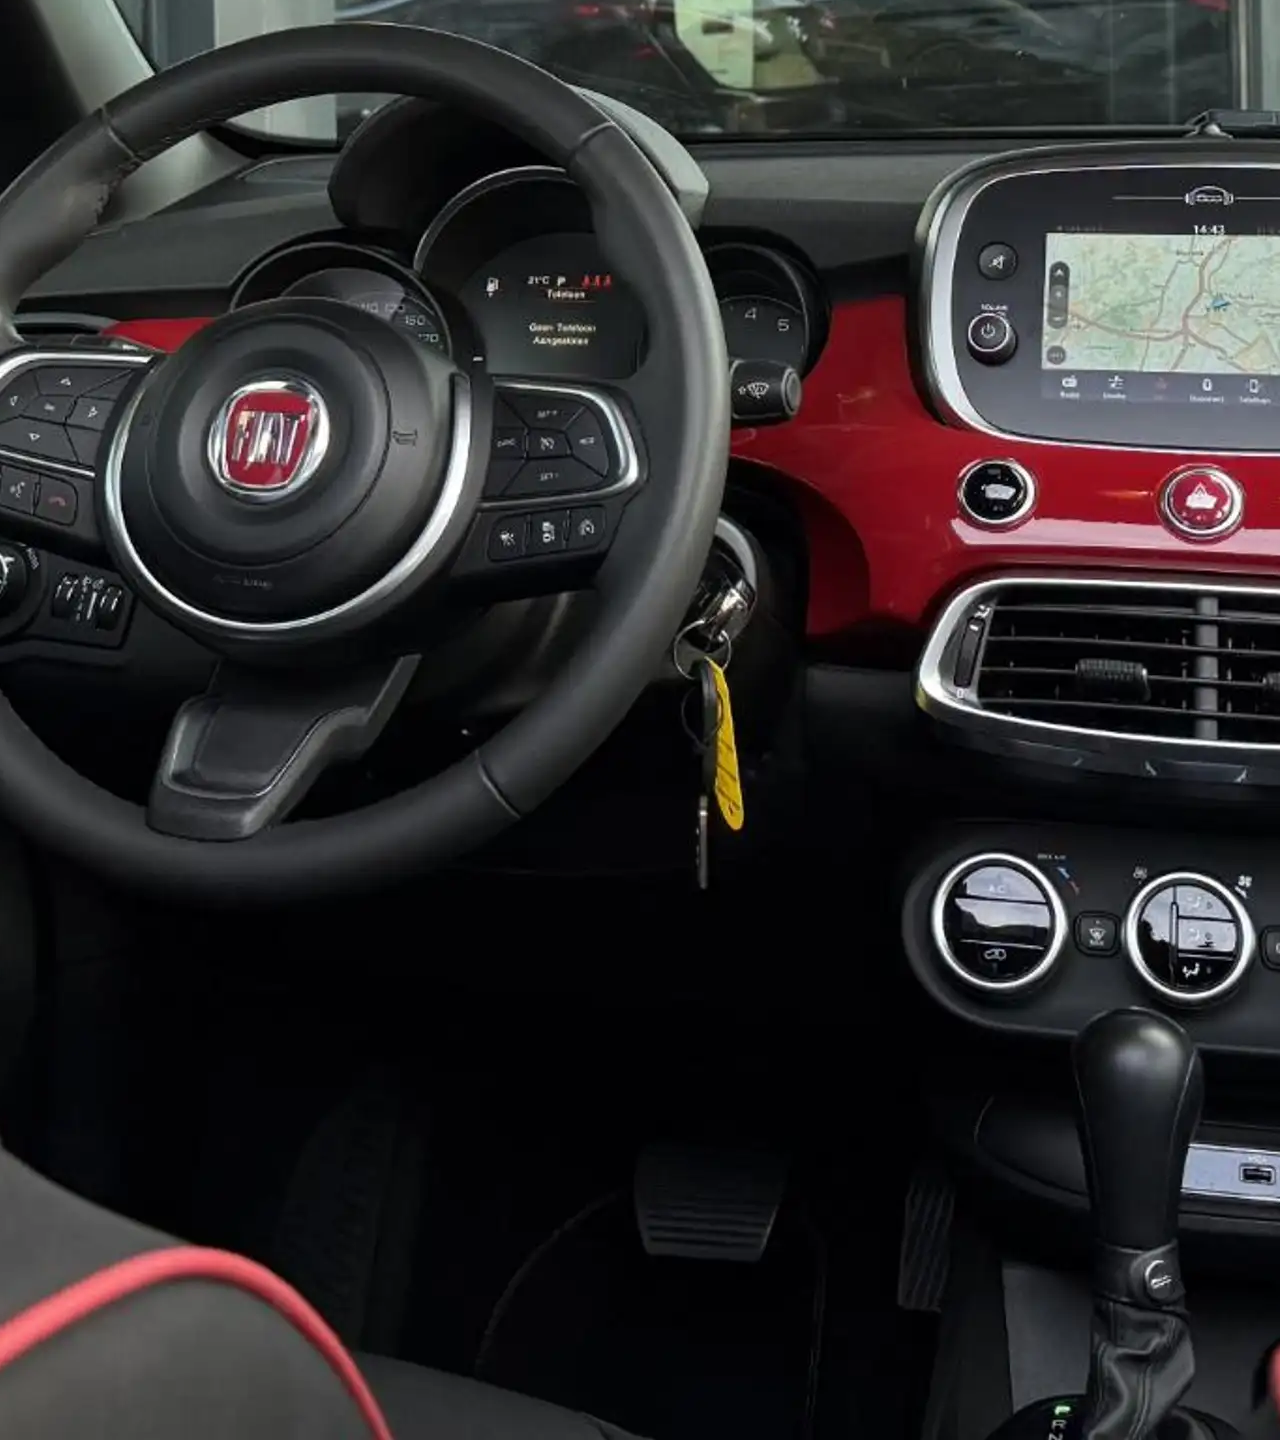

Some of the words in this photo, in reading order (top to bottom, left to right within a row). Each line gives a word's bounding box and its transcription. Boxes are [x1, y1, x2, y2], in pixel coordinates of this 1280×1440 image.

[744, 307, 758, 320] 4
[405, 315, 426, 327] 150
[777, 318, 790, 332] 5
[230, 409, 307, 466] FIAT
